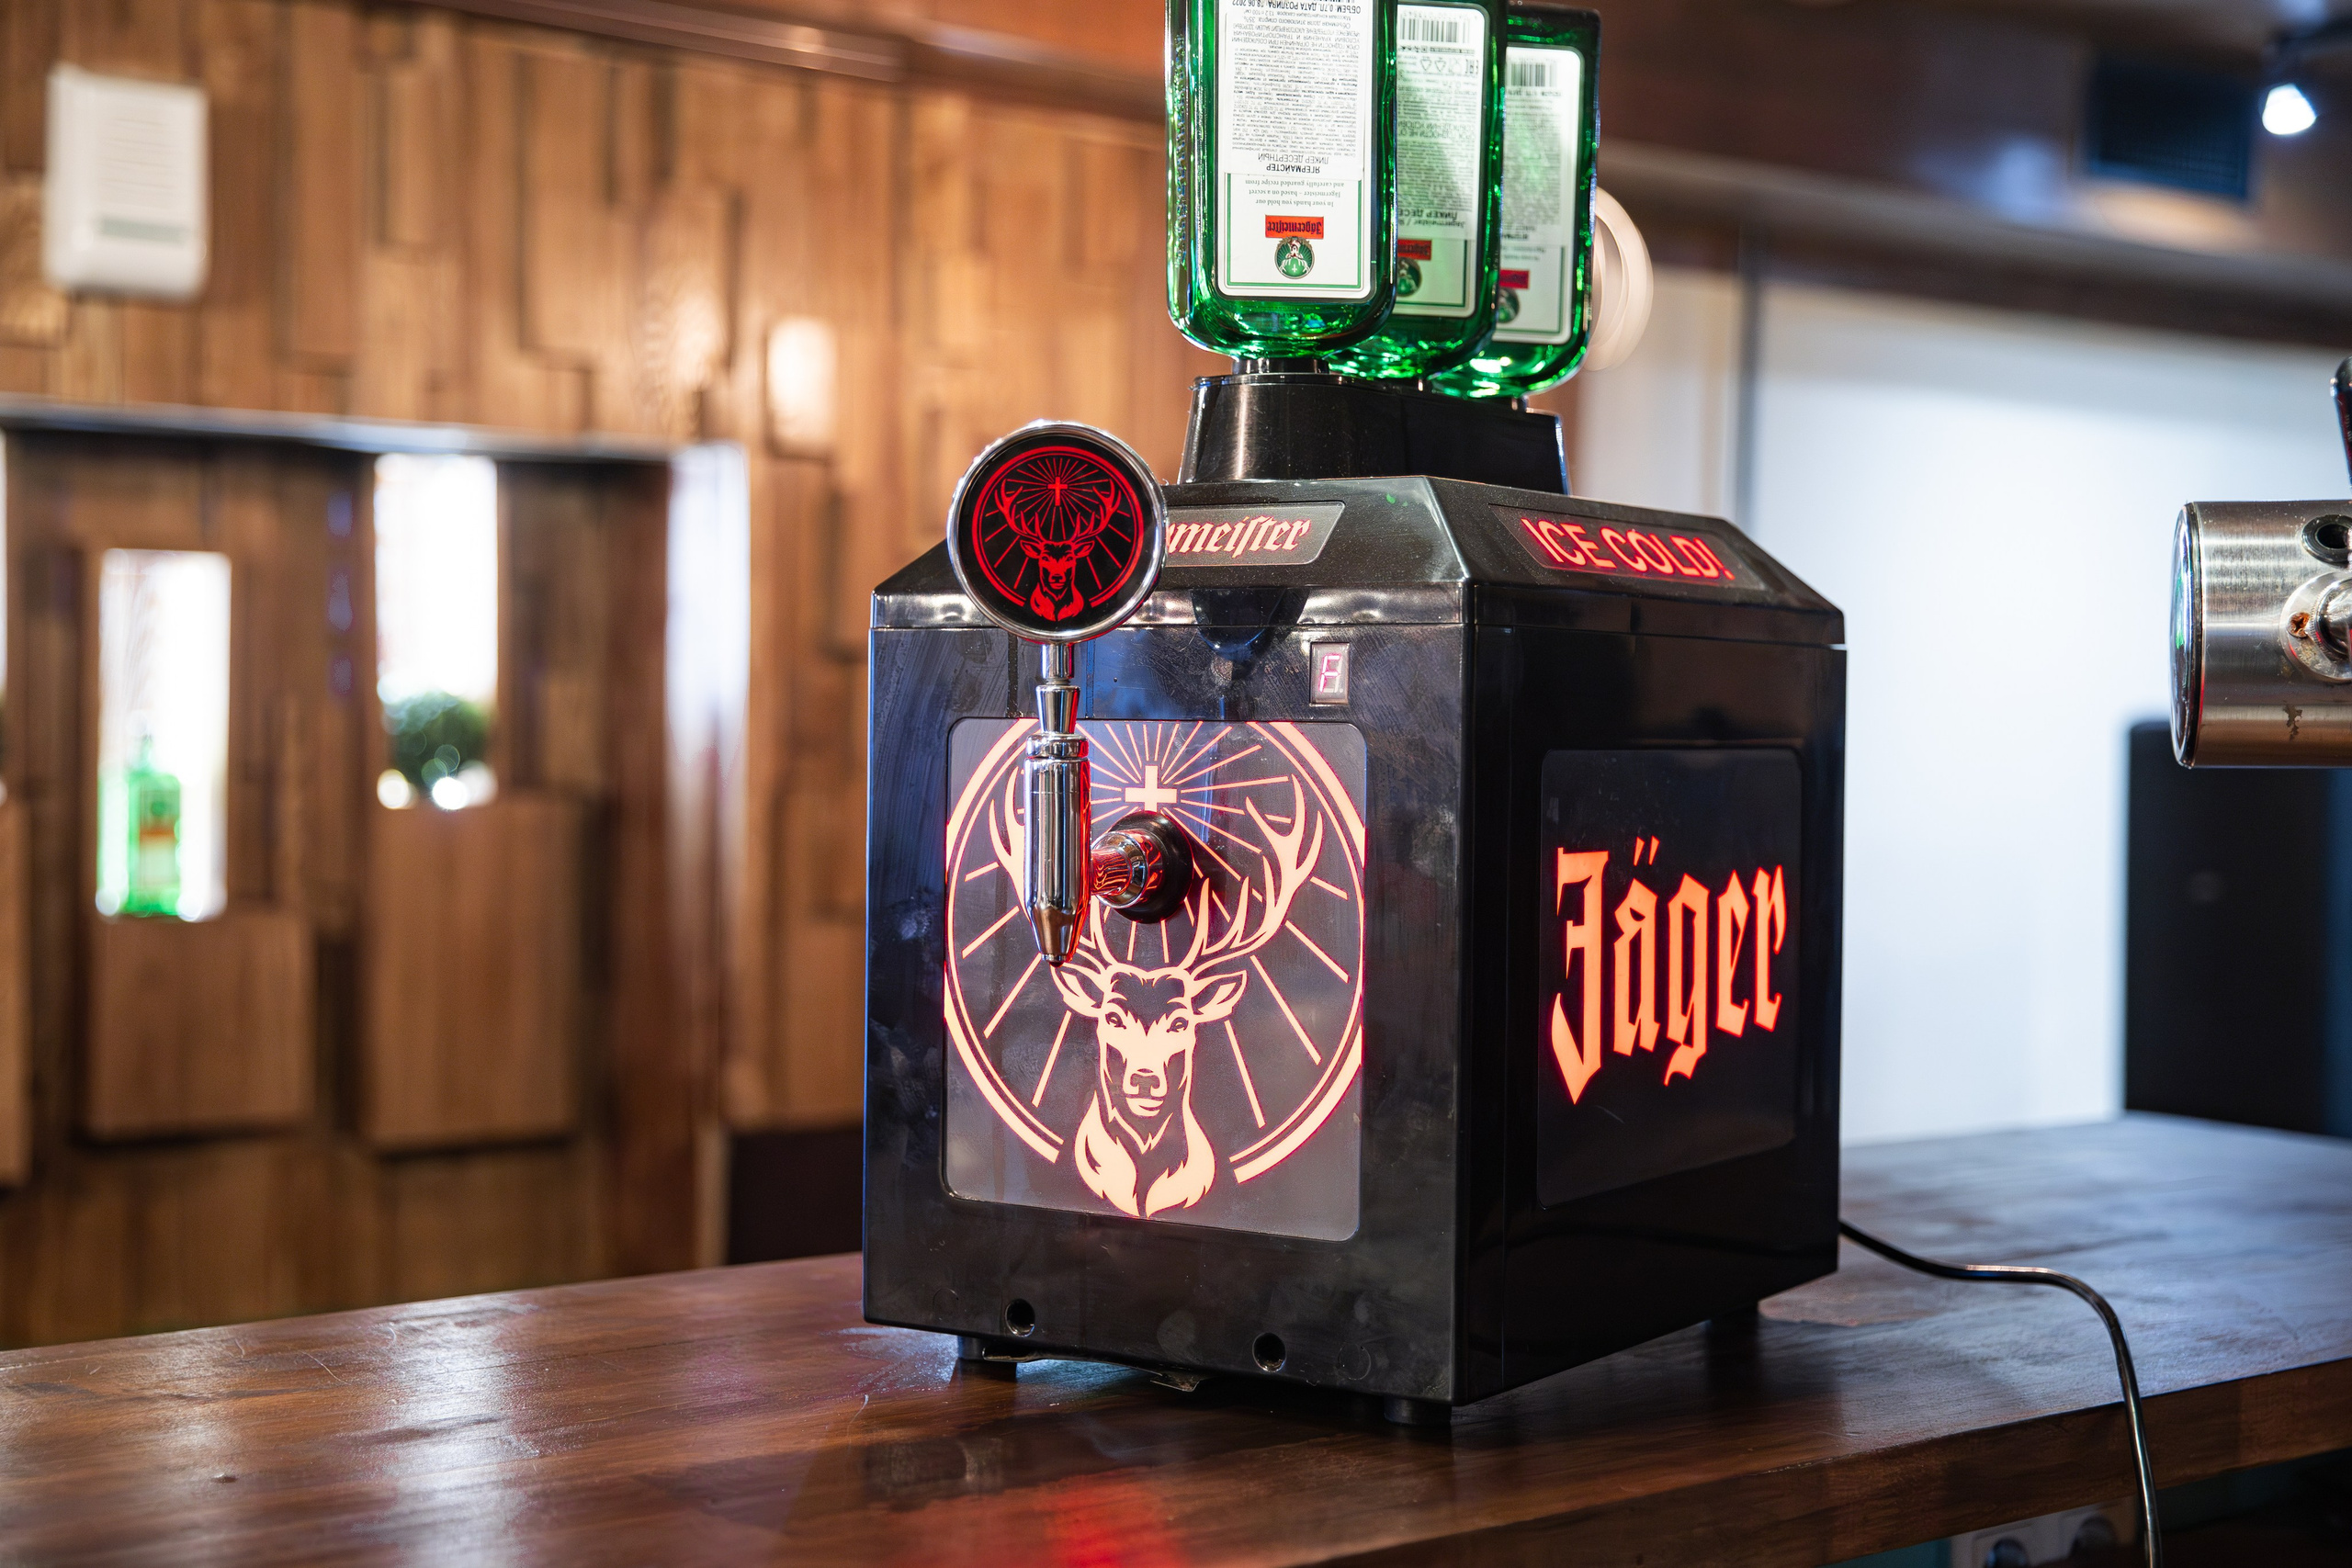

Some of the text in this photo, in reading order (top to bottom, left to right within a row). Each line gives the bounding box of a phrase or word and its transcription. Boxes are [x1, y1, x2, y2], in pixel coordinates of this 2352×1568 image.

[1300, 2, 1317, 12] ДАТА
[1257, 152, 1329, 165] ЛИКЕР ДЕСЕРТНЫЙ
[1265, 164, 1321, 175] ЯГЕРМАЙСТЕР
[1261, 178, 1280, 186] recipe
[1280, 179, 1305, 187] guarded
[1306, 180, 1332, 188] carefully
[1280, 189, 1298, 197] based
[1304, 189, 1341, 198] Jägermeister
[1426, 211, 1458, 220] ЛИКЕР
[1267, 220, 1322, 235] Jägermeister
[1521, 517, 1736, 581] ICE COLD!
[1551, 835, 1788, 1105] Jäger
